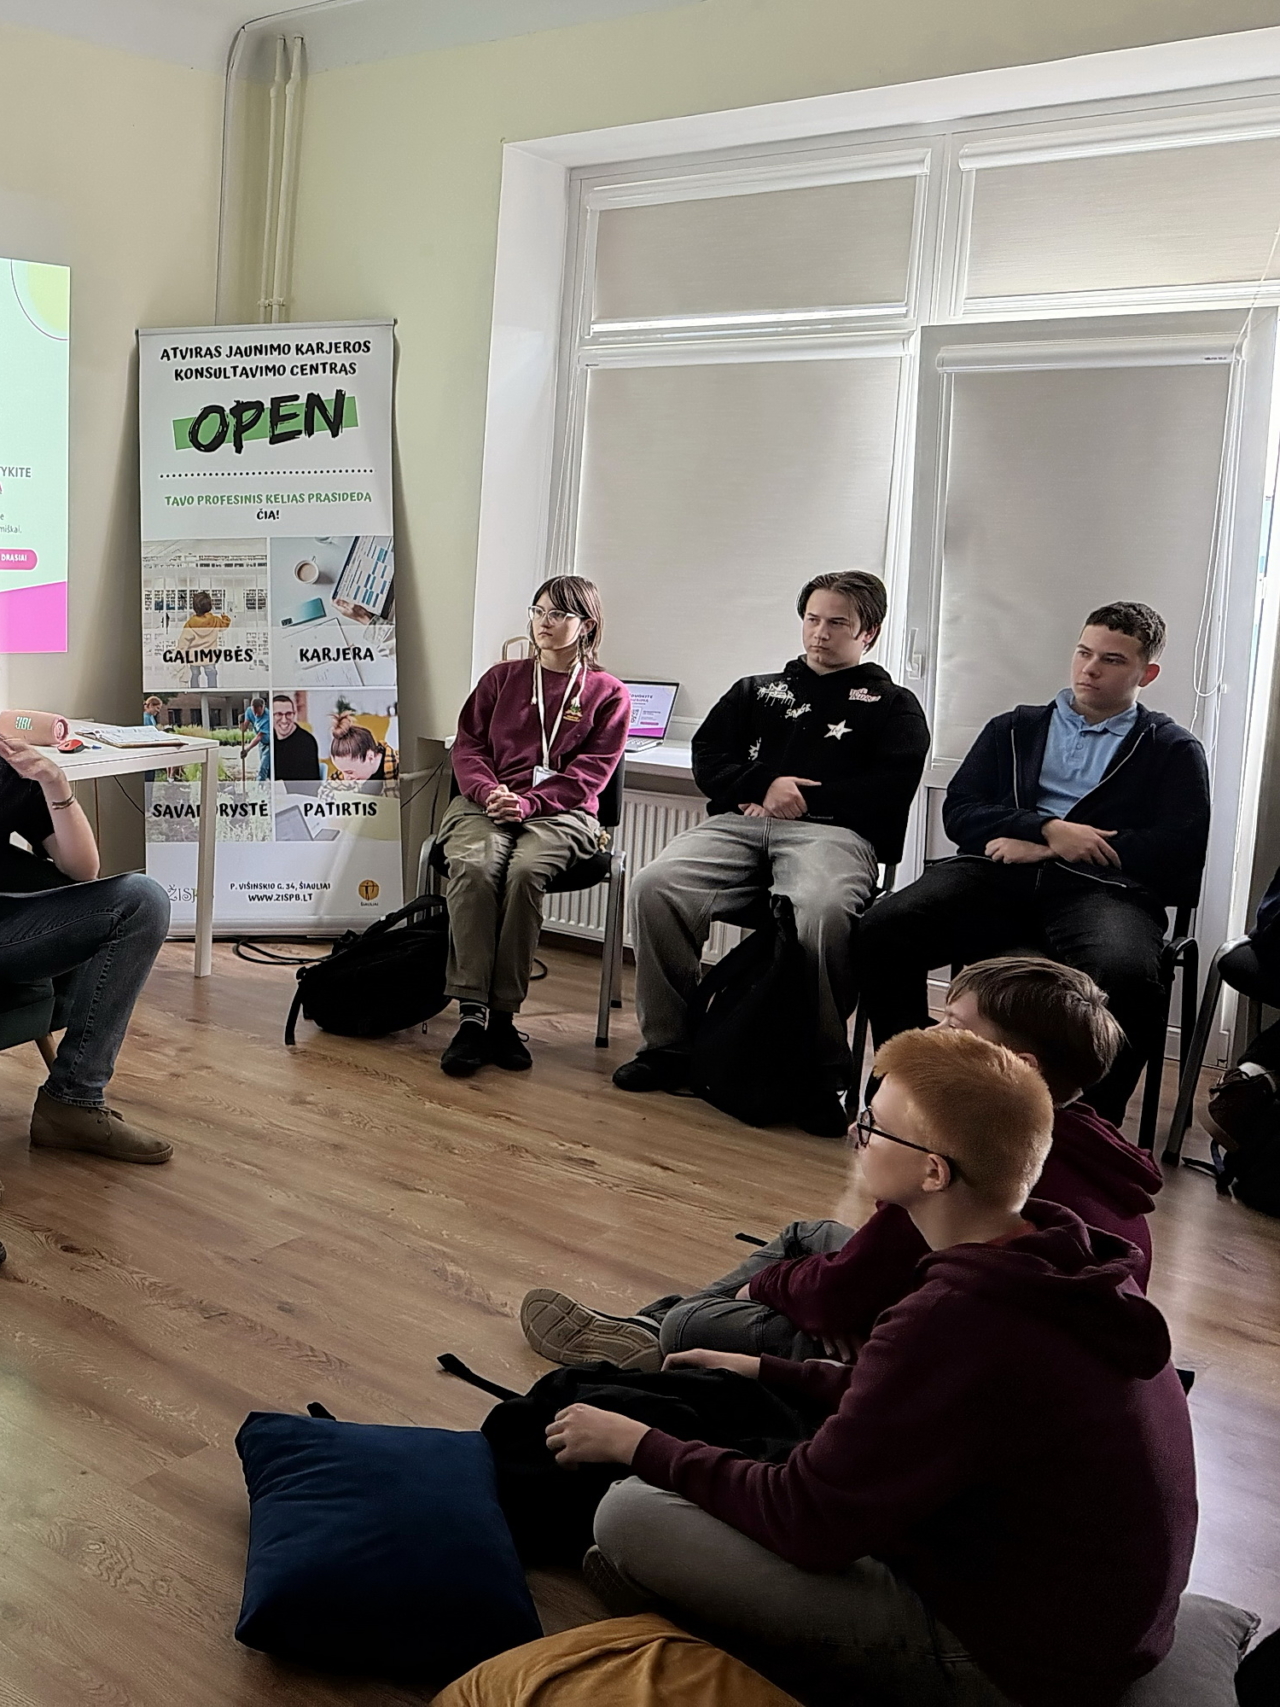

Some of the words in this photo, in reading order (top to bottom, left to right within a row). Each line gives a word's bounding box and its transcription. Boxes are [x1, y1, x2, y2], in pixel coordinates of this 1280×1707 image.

[160, 345, 222, 361] ATVIRAS
[225, 342, 291, 358] JAUNIMO
[295, 340, 371, 355] KARJEROS
[174, 364, 287, 381] KONSULTAVIMO
[289, 361, 357, 377] CENTRAS
[188, 388, 346, 454] OPEN
[164, 494, 195, 506] TAVO
[197, 493, 263, 506] PROFESINIS
[265, 492, 305, 504] KELIAS
[307, 491, 372, 504] PRASIDEDA
[256, 508, 280, 521] ČIA!
[162, 646, 254, 664] GALIMYBĖS
[299, 647, 375, 663] KARJERA
[15, 717, 32, 730] JBL
[153, 800, 268, 819] SAVARYSTĖ
[304, 801, 378, 818] PATIRTIS
[239, 881, 275, 891] VIŠINSKIO
[277, 882, 285, 890] G.
[286, 882, 297, 892] 34,
[299, 881, 331, 890] ŠIAULIAI
[248, 893, 313, 903] WWW.ZISPB.LT
